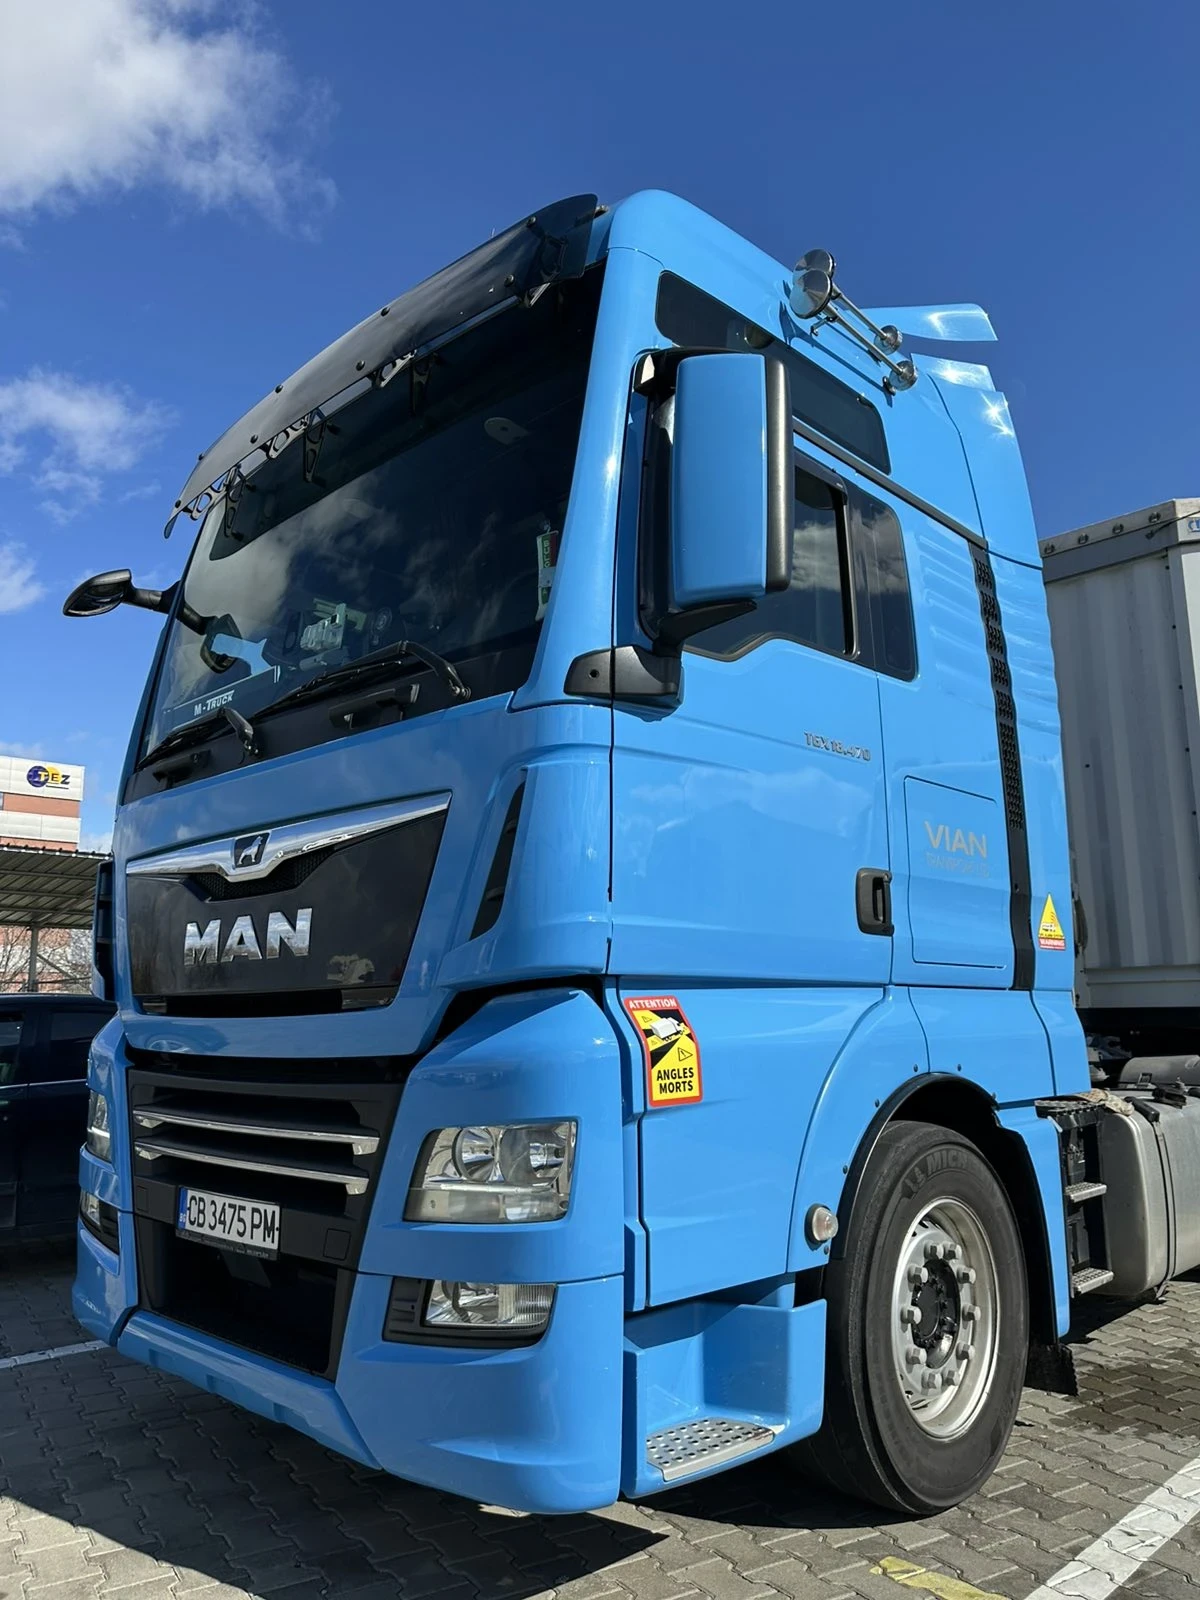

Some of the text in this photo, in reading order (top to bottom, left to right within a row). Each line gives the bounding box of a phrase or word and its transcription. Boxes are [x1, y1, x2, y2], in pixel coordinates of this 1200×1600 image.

[923, 819, 988, 859] VIAN
[183, 908, 313, 966] MAN
[628, 998, 678, 1009] ATTENTION
[656, 1067, 695, 1082] ANGLES
[659, 1080, 694, 1095] MORTS
